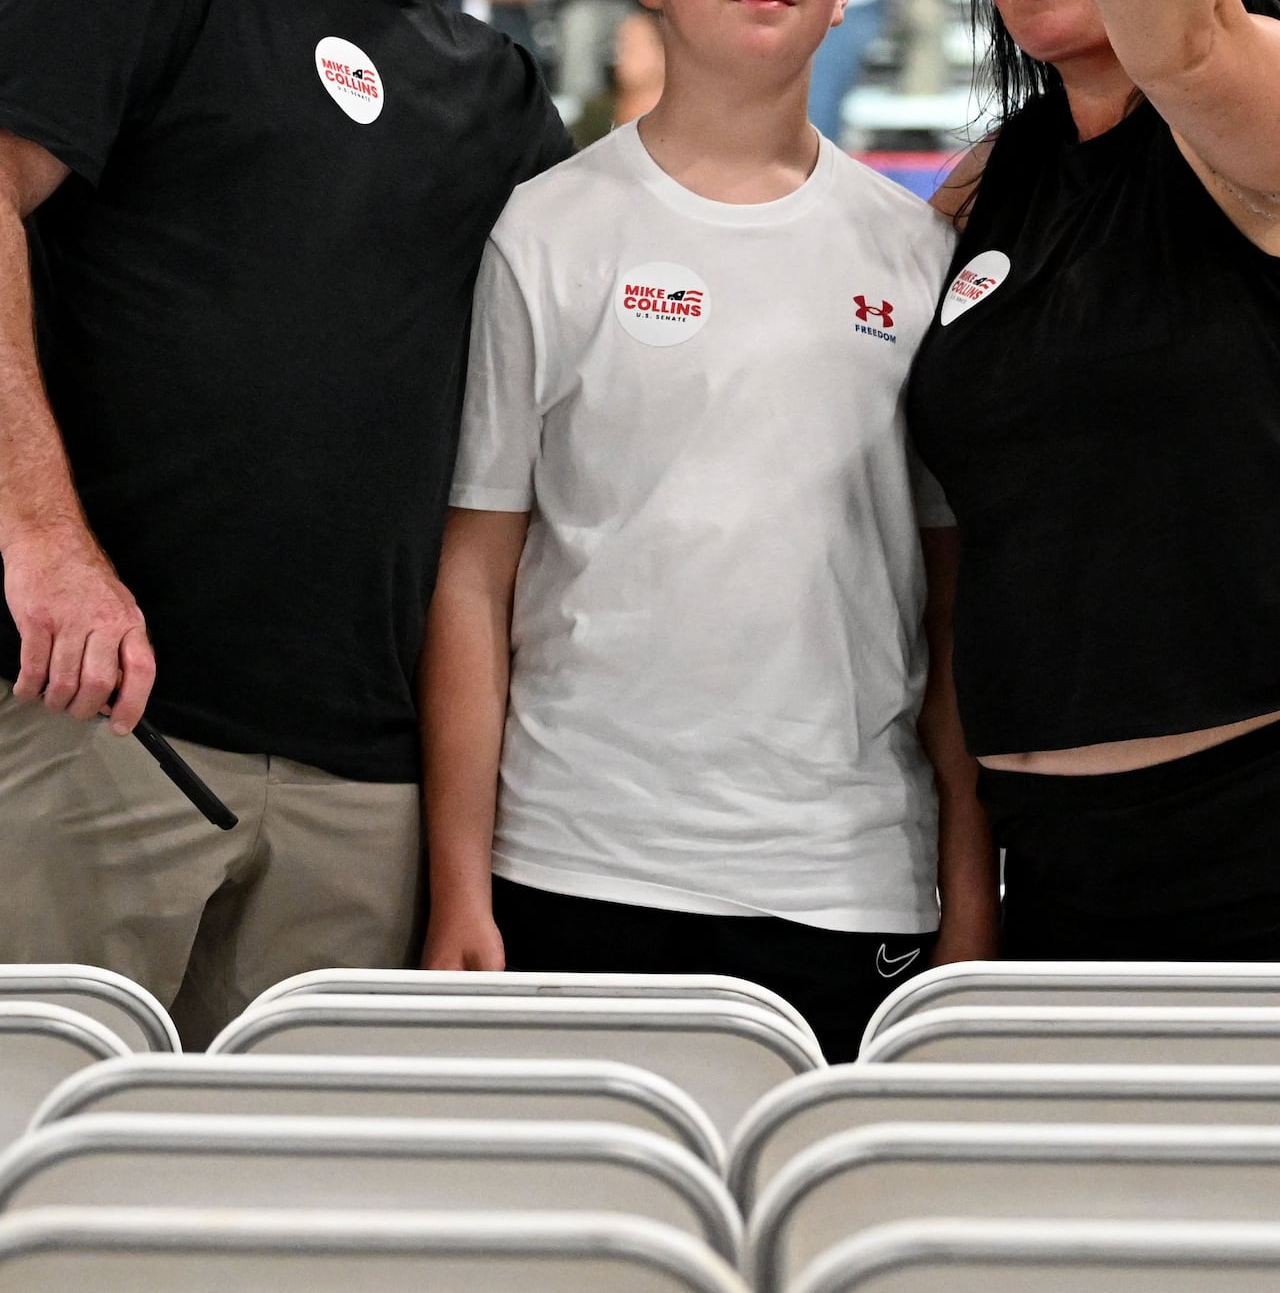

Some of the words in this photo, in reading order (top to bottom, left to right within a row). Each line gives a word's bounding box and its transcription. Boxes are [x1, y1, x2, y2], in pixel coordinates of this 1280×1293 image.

[321, 57, 351, 76] MIKE
[325, 69, 379, 99] COLLINS
[624, 284, 665, 299] MIKE
[623, 296, 702, 317] COLLINS
[656, 314, 687, 323] SENATE
[855, 324, 896, 345] FREEDOM
